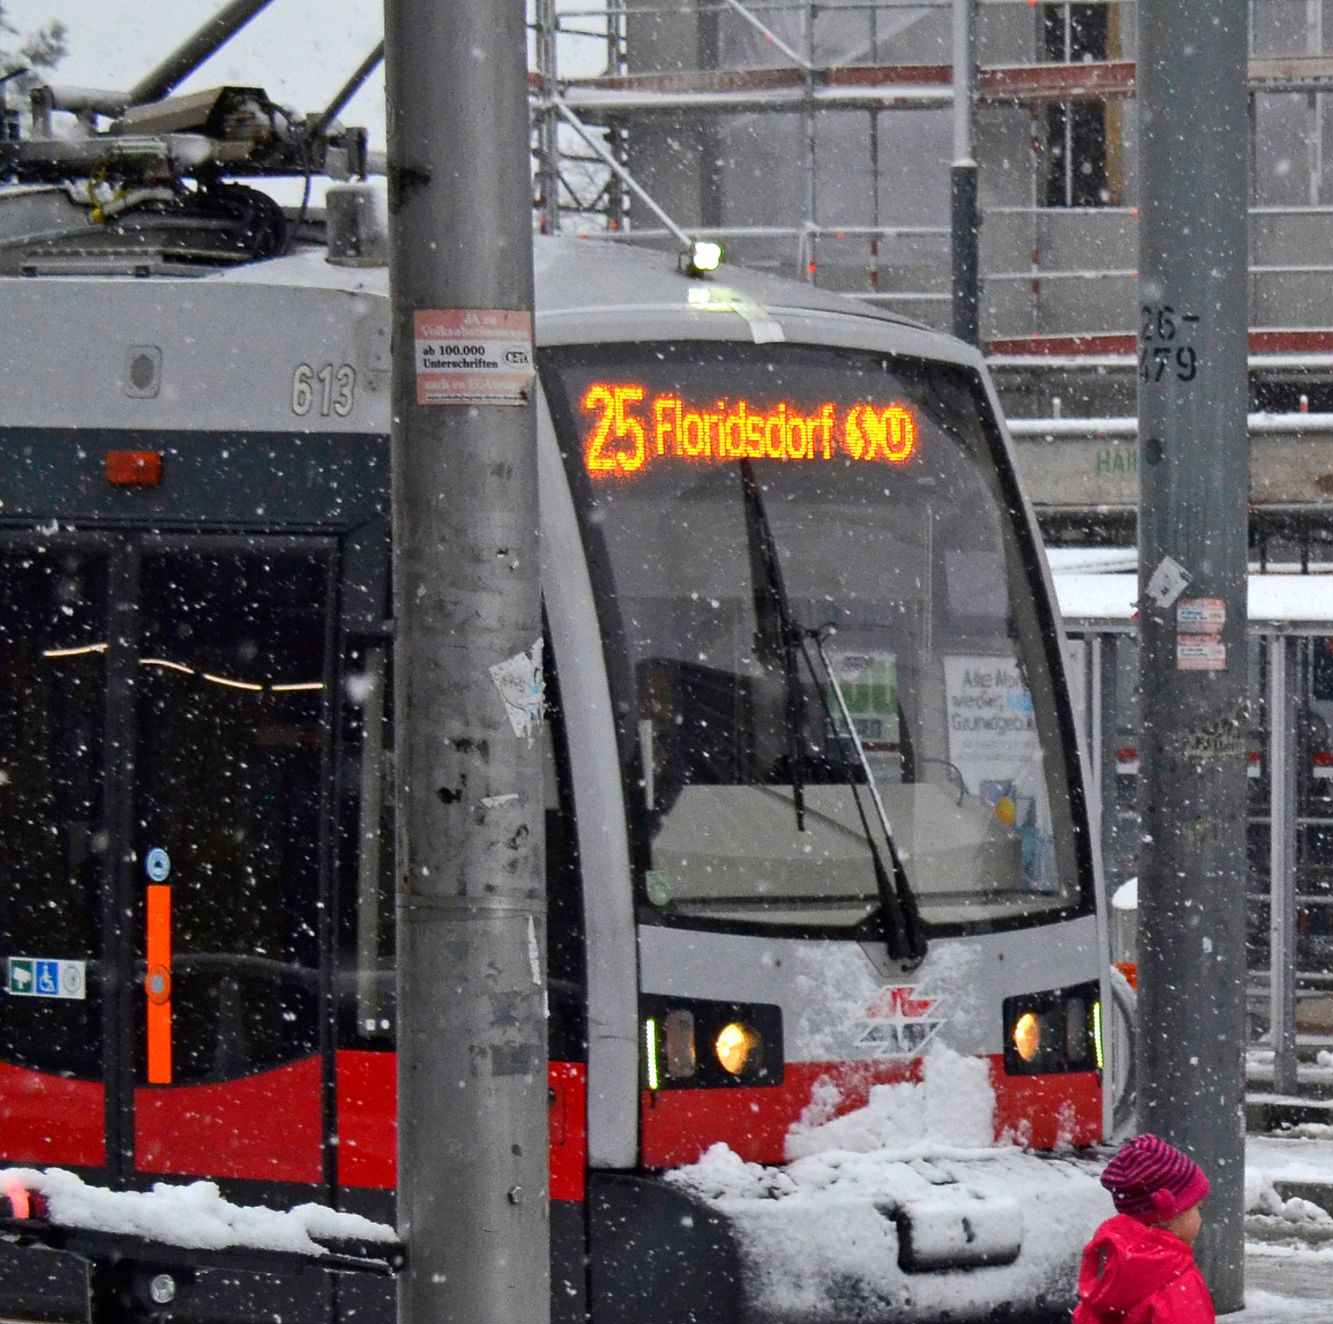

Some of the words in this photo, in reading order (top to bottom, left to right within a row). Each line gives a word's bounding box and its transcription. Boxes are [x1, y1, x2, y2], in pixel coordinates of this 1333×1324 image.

[422, 358, 499, 369] Unterschriften
[423, 345, 435, 356] ab
[439, 345, 486, 356] 100.000
[292, 363, 357, 418] 613
[584, 384, 647, 474] 25
[654, 398, 835, 461] Floridsdorf
